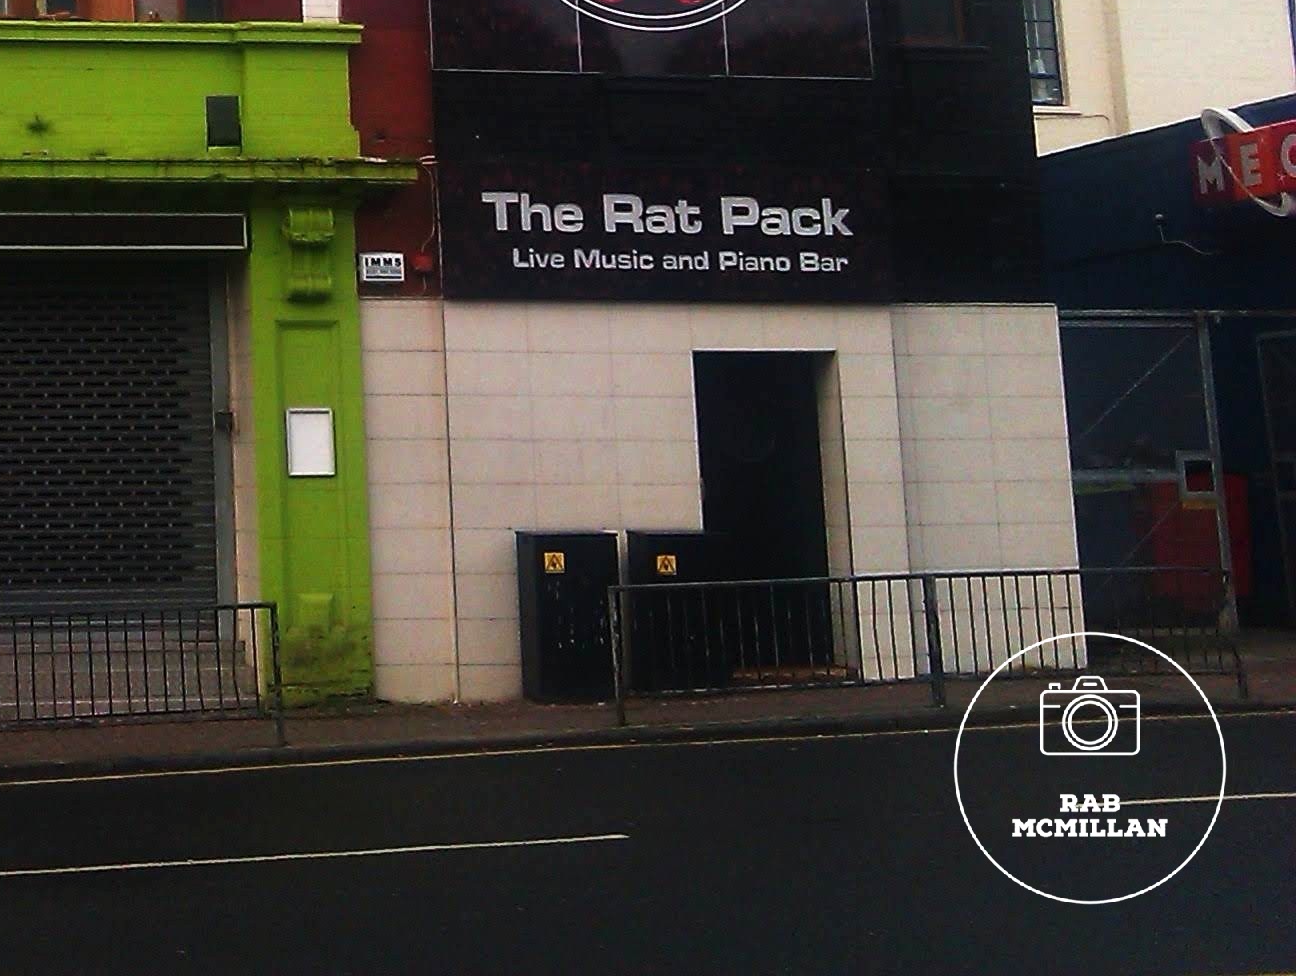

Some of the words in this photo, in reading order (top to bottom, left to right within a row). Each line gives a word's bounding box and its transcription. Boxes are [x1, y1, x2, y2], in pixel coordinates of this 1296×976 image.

[481, 191, 584, 233] The
[603, 192, 703, 235] Rat
[720, 195, 853, 237] Pack
[512, 247, 565, 269] Live
[573, 248, 654, 270] Music
[662, 249, 710, 271] and
[719, 250, 791, 272] Piano
[800, 252, 849, 273] Bar
